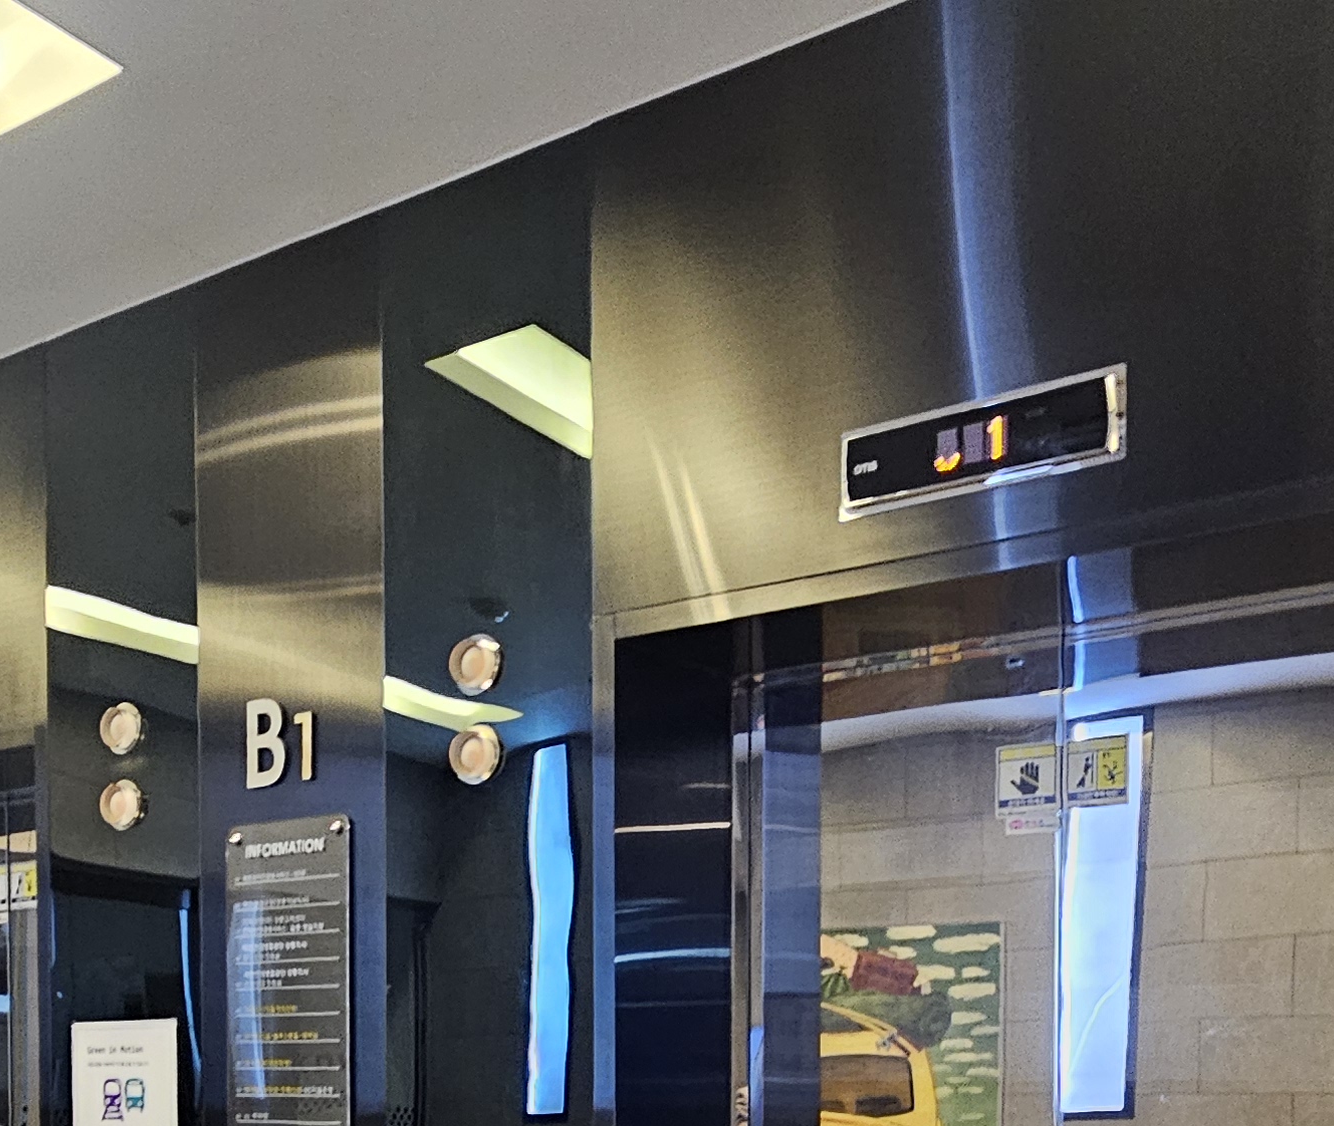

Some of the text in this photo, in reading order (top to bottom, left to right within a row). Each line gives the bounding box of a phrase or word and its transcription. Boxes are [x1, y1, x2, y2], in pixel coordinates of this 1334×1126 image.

[987, 415, 1003, 460] 1
[246, 698, 312, 789] B1
[244, 836, 325, 859] INFORMATION
